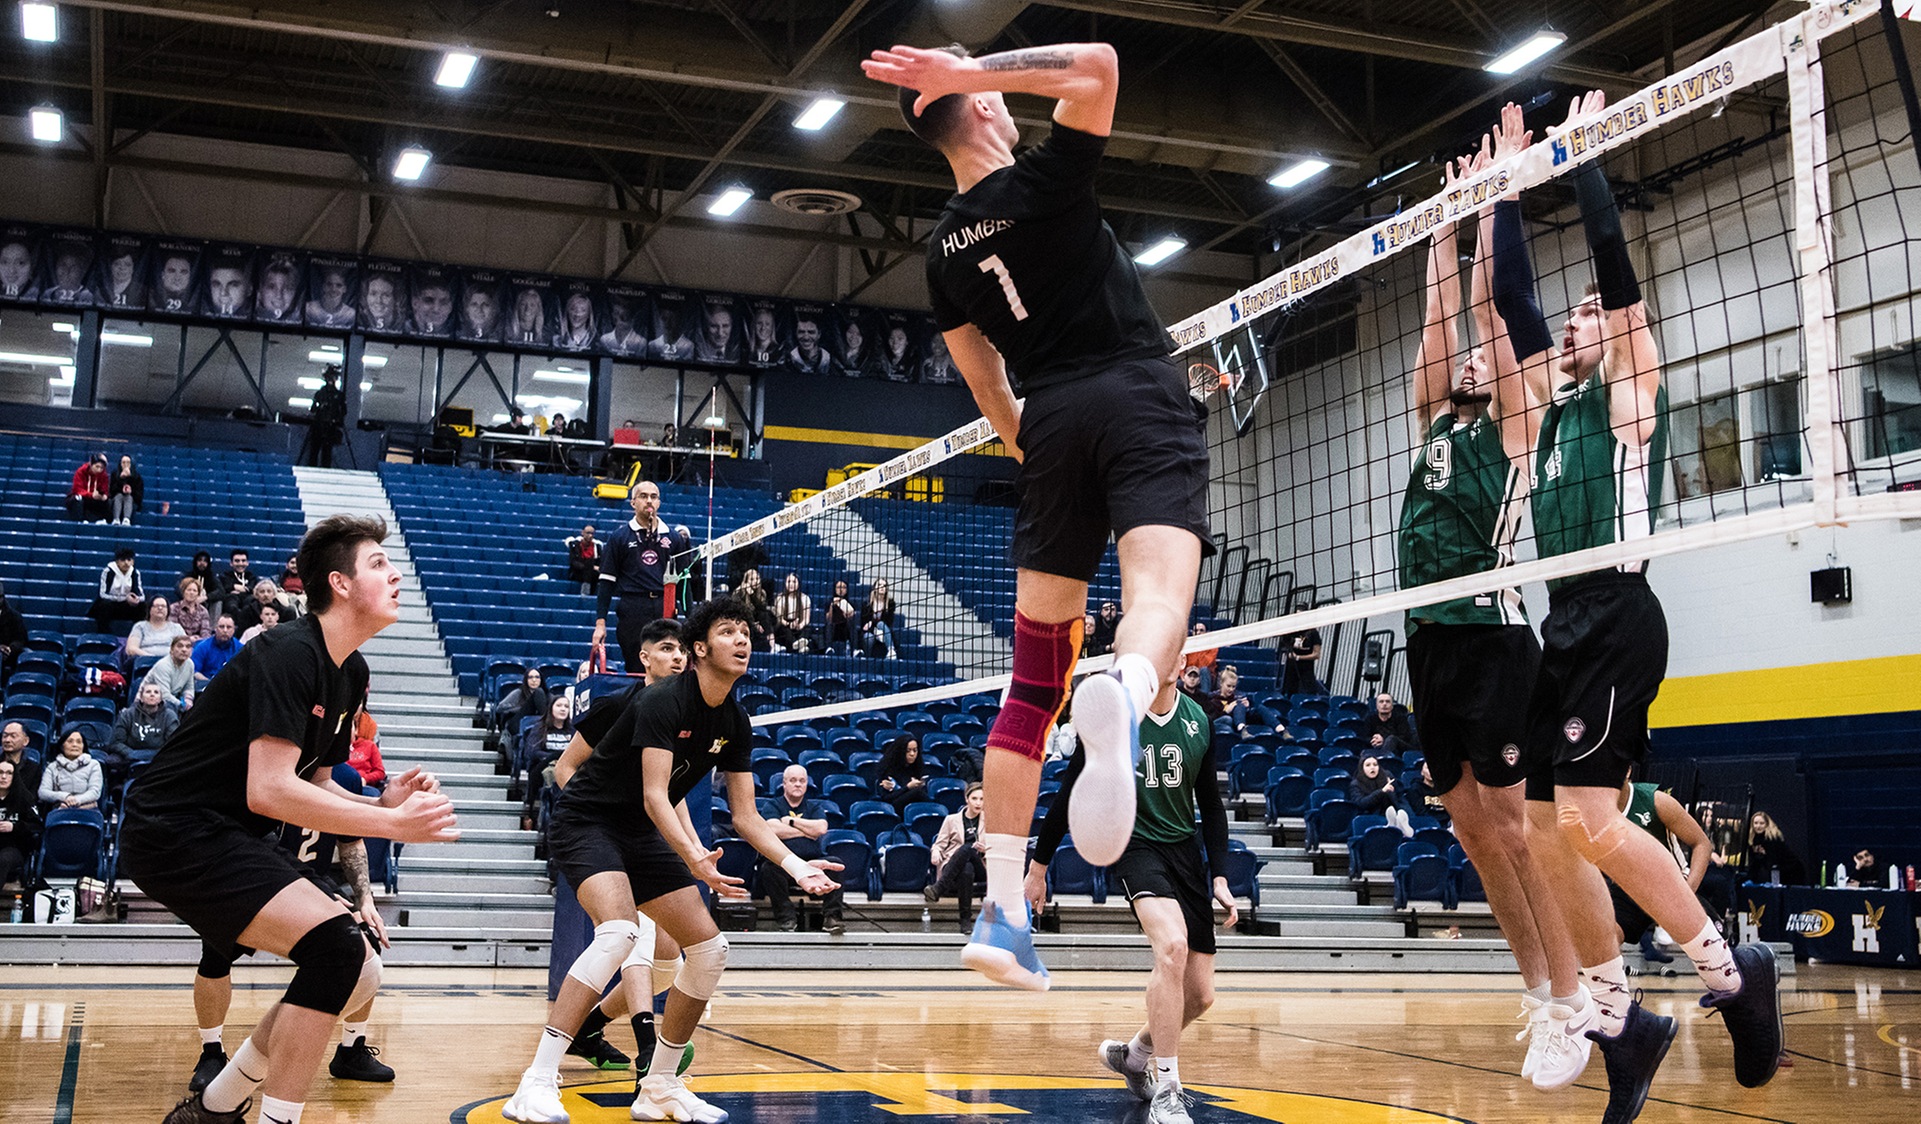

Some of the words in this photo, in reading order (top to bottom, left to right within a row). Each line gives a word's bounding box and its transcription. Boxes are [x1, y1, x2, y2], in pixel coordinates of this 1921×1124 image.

[1569, 101, 1648, 157] HUMBER
[1650, 60, 1735, 117] HAWKS
[5, 284, 19, 297] 18
[976, 253, 1030, 322] 1
[60, 289, 75, 301] 22
[113, 294, 127, 306] 21
[166, 298, 182, 311] 29
[220, 304, 234, 316] 14
[273, 308, 282, 320] 9
[325, 314, 334, 325] 2
[375, 318, 385, 330] 5
[425, 322, 434, 333] 3
[474, 327, 483, 339] 3
[523, 331, 536, 343] 11
[1169, 320, 1207, 347] AWKS
[663, 343, 678, 355] 23
[756, 352, 770, 363] 10
[933, 365, 947, 378] 24
[1423, 436, 1453, 491] 9
[1142, 743, 1184, 788] 13
[297, 826, 321, 863] 2
[1851, 913, 1881, 954] H
